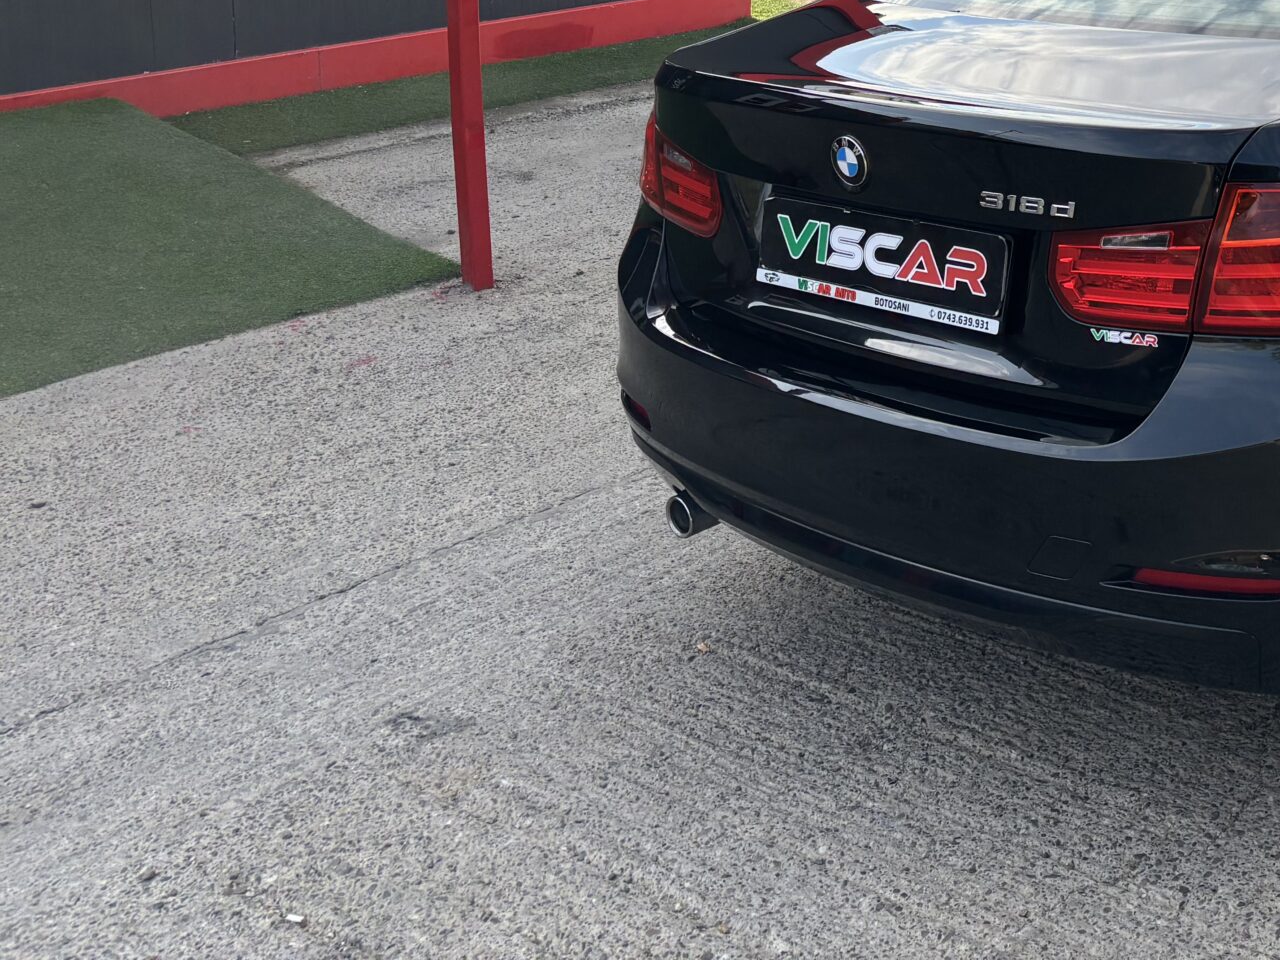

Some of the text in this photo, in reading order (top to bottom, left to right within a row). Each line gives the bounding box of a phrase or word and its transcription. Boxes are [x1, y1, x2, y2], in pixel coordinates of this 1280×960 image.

[777, 214, 987, 298] VISCAR
[797, 278, 989, 330] VISCAR AUTO BOTOSANI 0743.639.931
[1089, 328, 1158, 347] VISCAR
